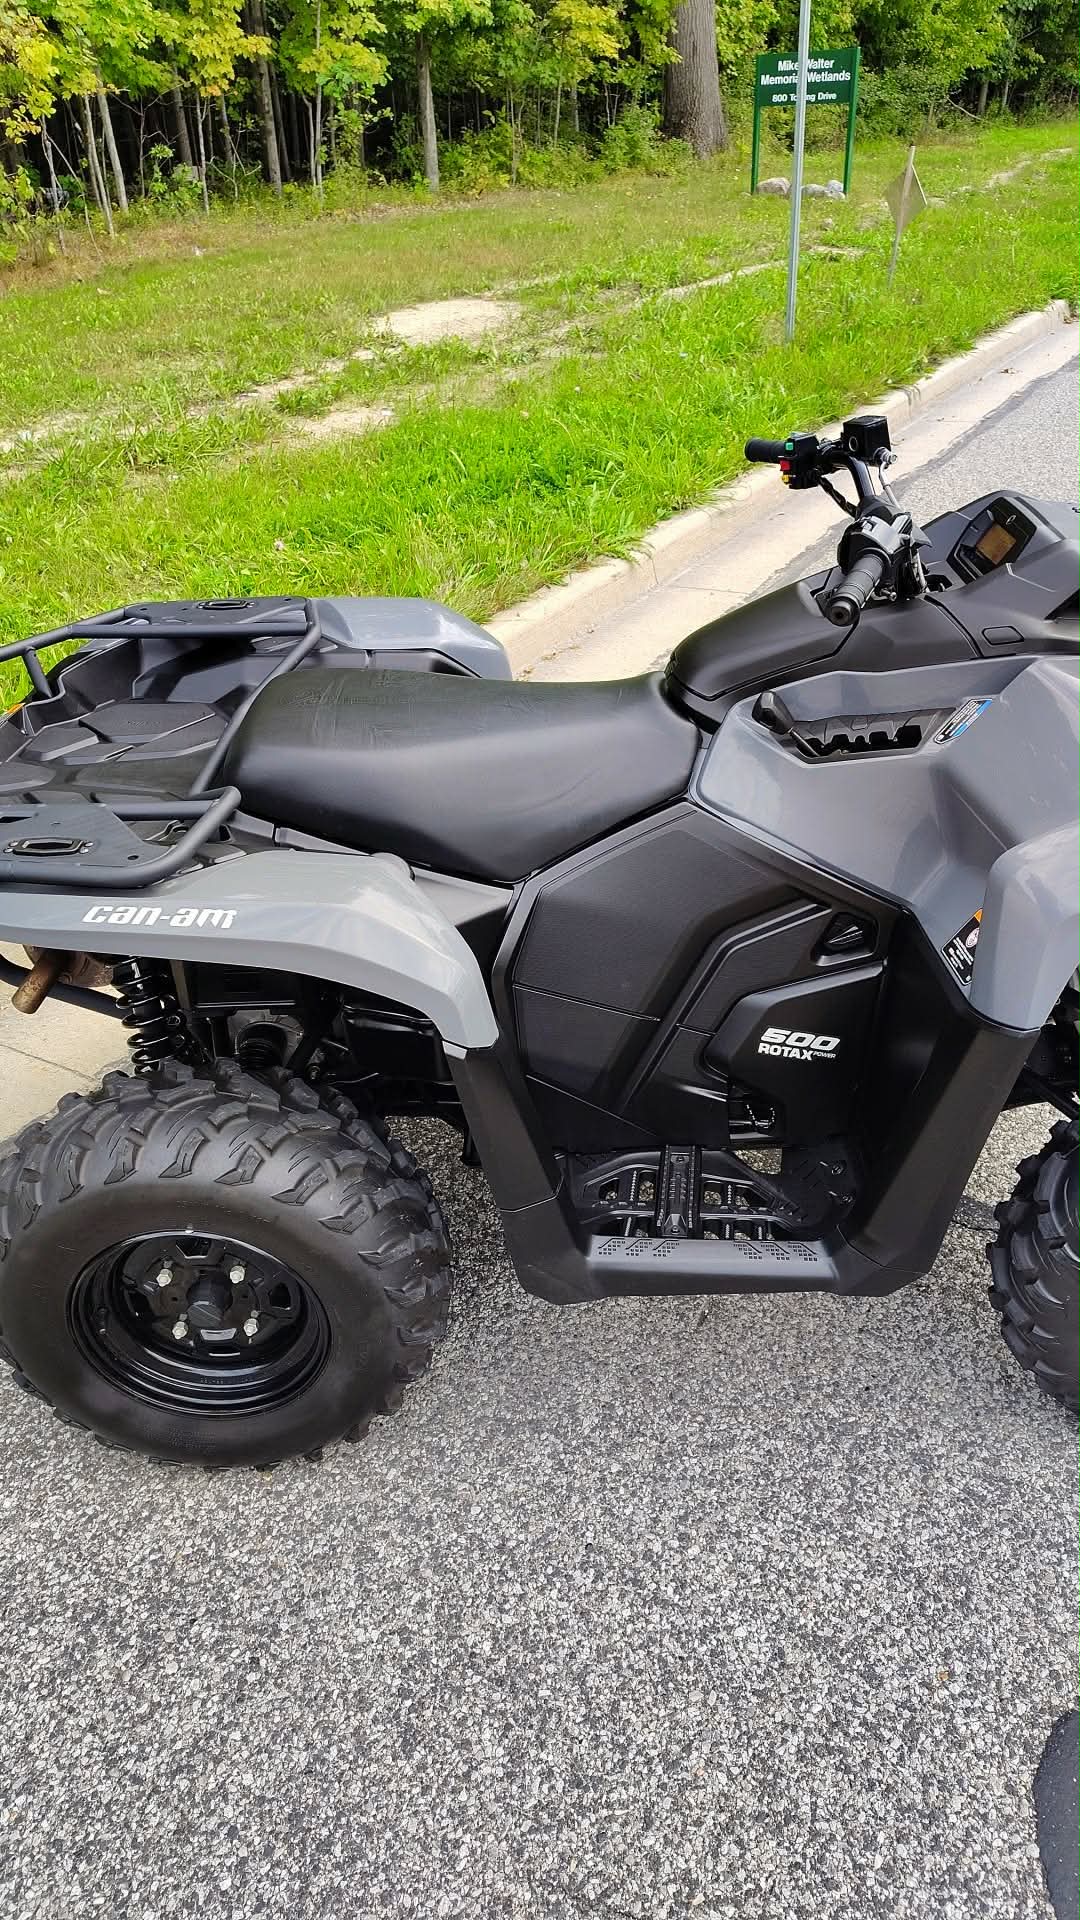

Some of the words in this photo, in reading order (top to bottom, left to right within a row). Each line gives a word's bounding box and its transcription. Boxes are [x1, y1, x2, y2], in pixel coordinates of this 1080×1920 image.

[778, 60, 800, 71] Mike
[760, 73, 799, 85] Memoria
[806, 70, 851, 83] Wetlands
[772, 94, 788, 102] 800
[818, 92, 837, 101] Drive
[82, 905, 237, 929] can-am
[760, 1027, 841, 1051] 500
[758, 1042, 813, 1061] ROTAX
[813, 1050, 837, 1059] POWER
